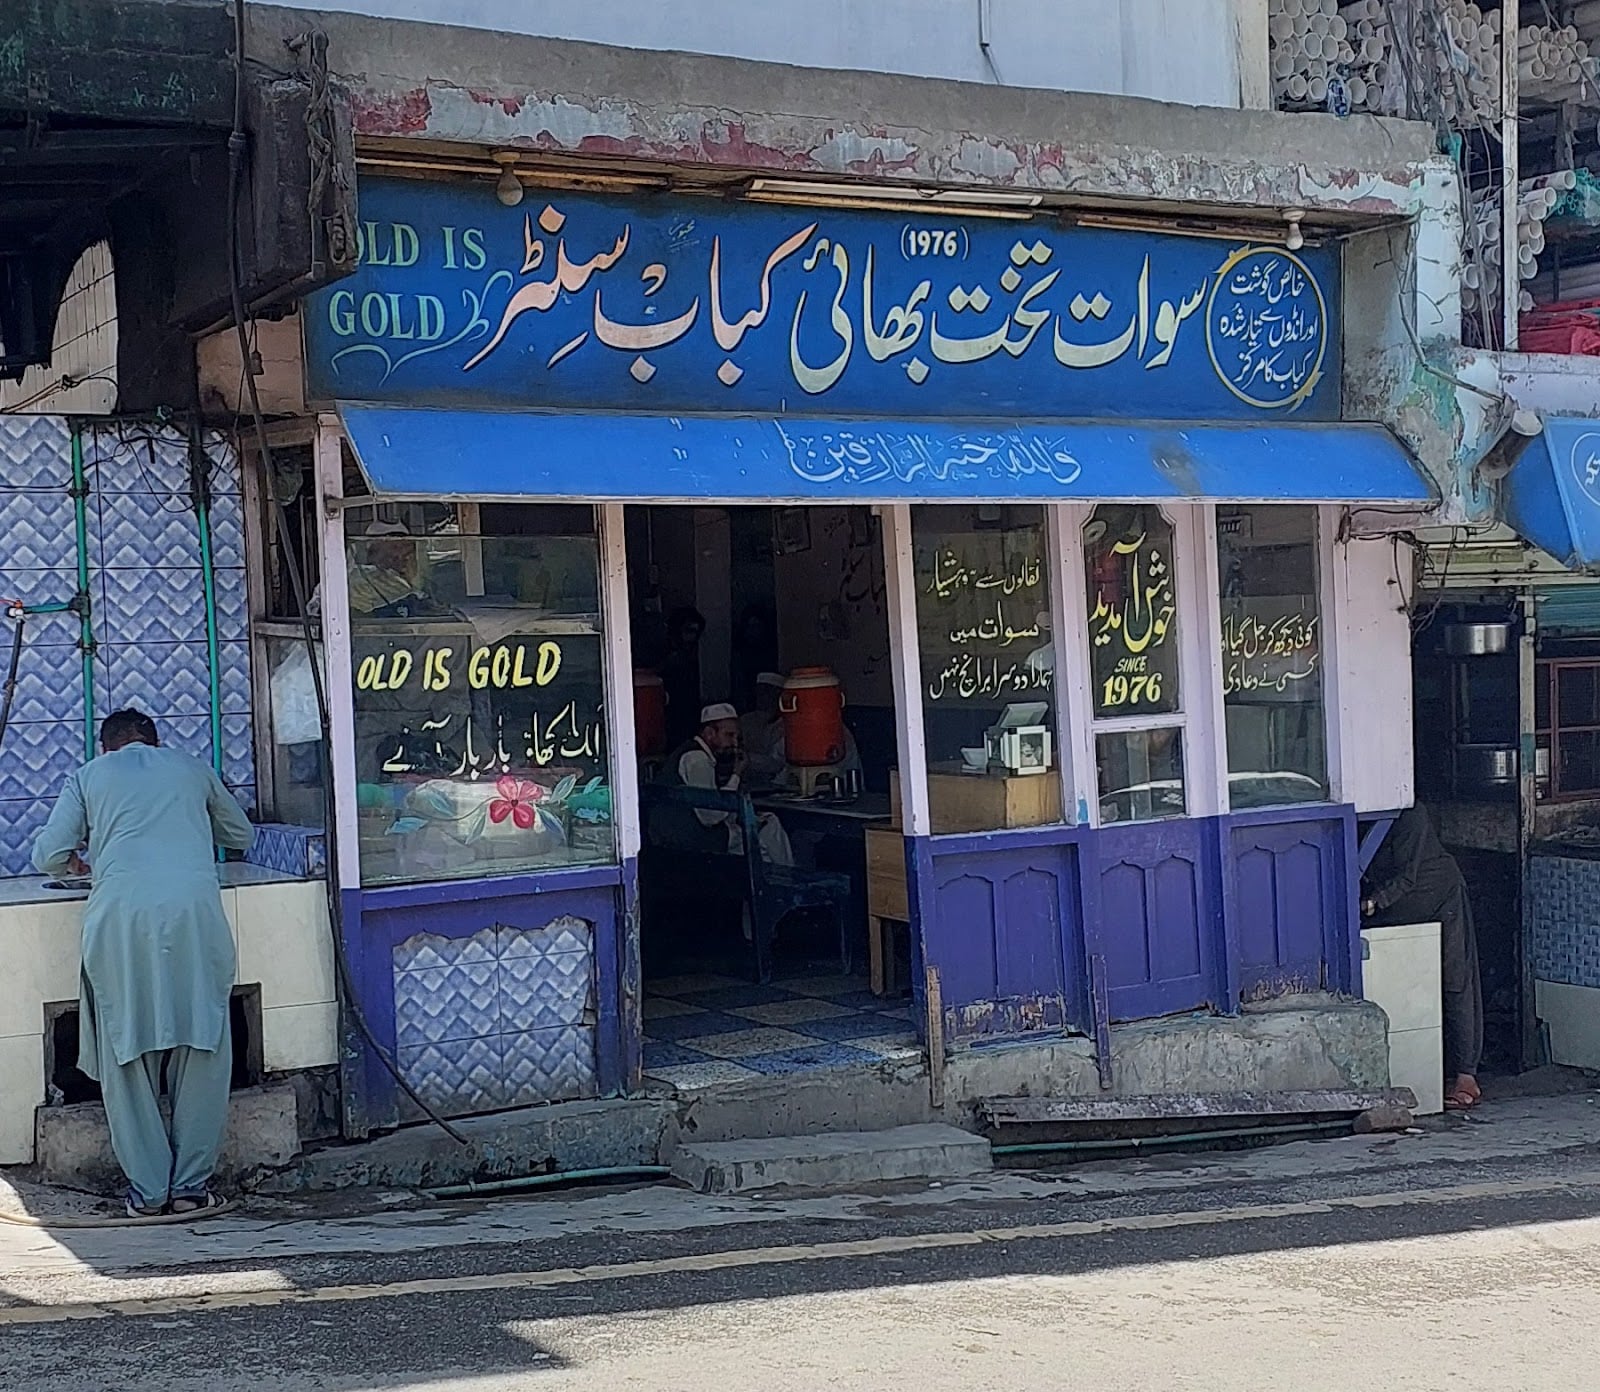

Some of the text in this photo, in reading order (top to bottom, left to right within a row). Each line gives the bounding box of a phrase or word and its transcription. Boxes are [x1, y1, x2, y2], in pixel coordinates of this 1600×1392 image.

[354, 221, 487, 271] LD IS
[900, 223, 969, 262] (1976)
[593, 221, 819, 387] کباب
[929, 238, 1063, 364] تخت
[1230, 257, 1306, 304] خالص گوشت
[328, 290, 446, 341] GOLD
[789, 237, 932, 394] بھائی
[1053, 252, 1209, 369] سوات
[1239, 308, 1263, 347] تیار
[1299, 315, 1319, 342] اور
[1233, 343, 1315, 391] کباب کا مرکز
[1002, 556, 1042, 595] نقالوں
[1088, 531, 1176, 653] خوش آمدید
[950, 600, 1040, 647] سوات میں
[1243, 614, 1267, 659] جل
[357, 640, 562, 691] OLD IS GOLD
[929, 656, 960, 700] نہیں
[1114, 655, 1148, 673] SINCE
[1101, 672, 1163, 708] 1976
[450, 716, 481, 781] بار
